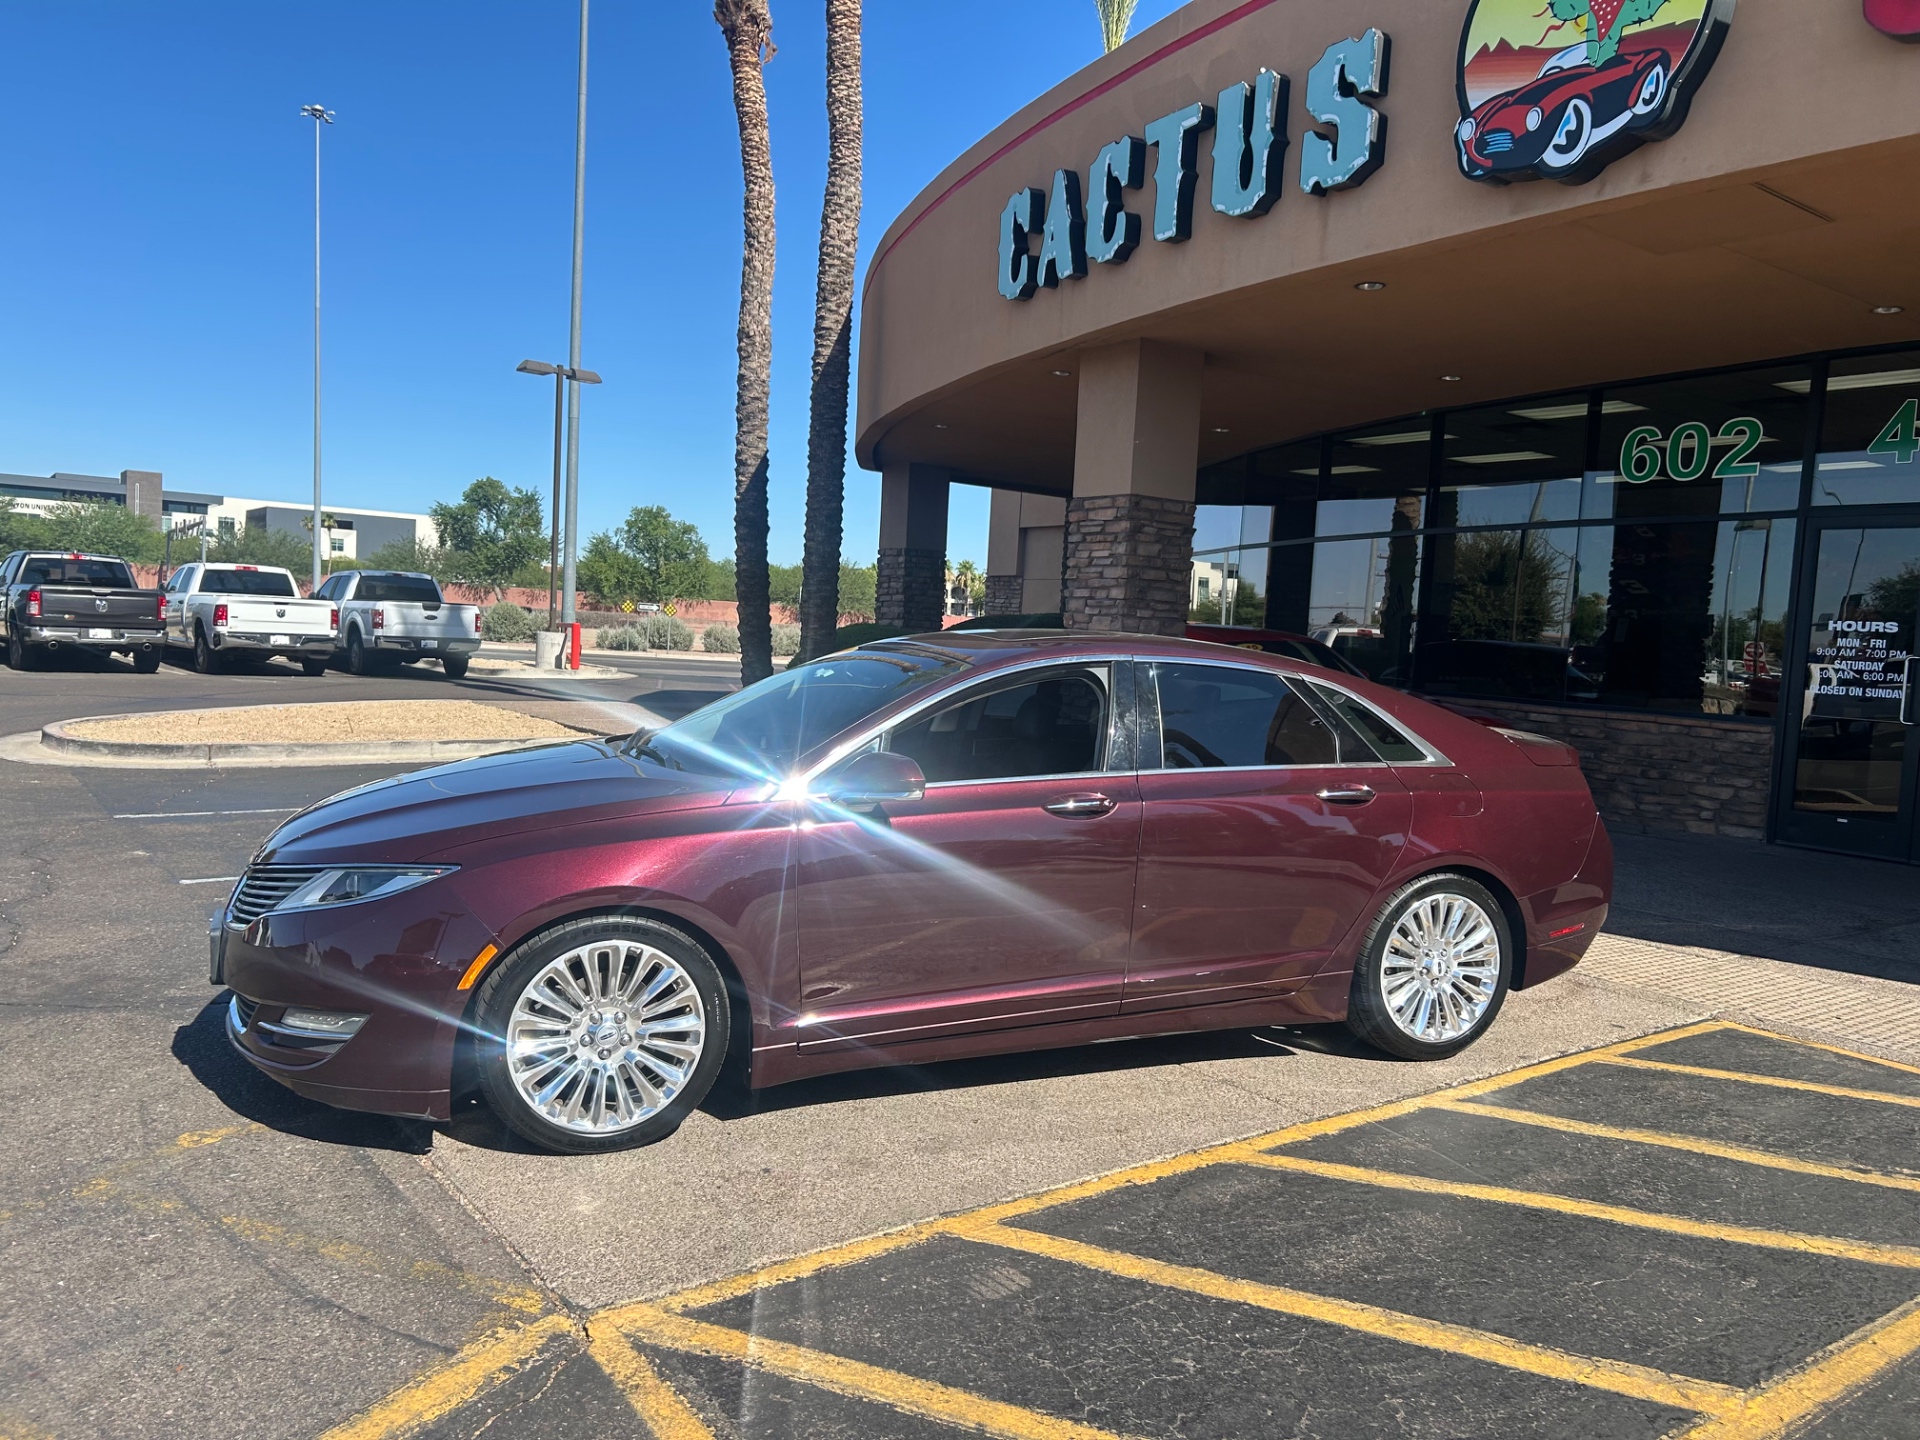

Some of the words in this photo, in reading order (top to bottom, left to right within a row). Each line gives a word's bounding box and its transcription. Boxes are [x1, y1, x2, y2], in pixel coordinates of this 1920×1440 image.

[997, 27, 1391, 302] CACTUS
[1619, 416, 1764, 484] 602
[1828, 620, 1899, 633] HOURS
[1836, 638, 1860, 648] MON
[1869, 639, 1887, 649] FRI
[1816, 647, 1837, 656] 9:00
[1838, 648, 1856, 657] AM
[1865, 649, 1887, 658] 7:00
[1889, 650, 1907, 659] PM
[1834, 660, 1885, 671] SATURDAY
[1836, 671, 1854, 680] AM
[1862, 672, 1884, 681] 6:00
[1886, 673, 1904, 682] PM
[1848, 686, 1863, 697] ON
